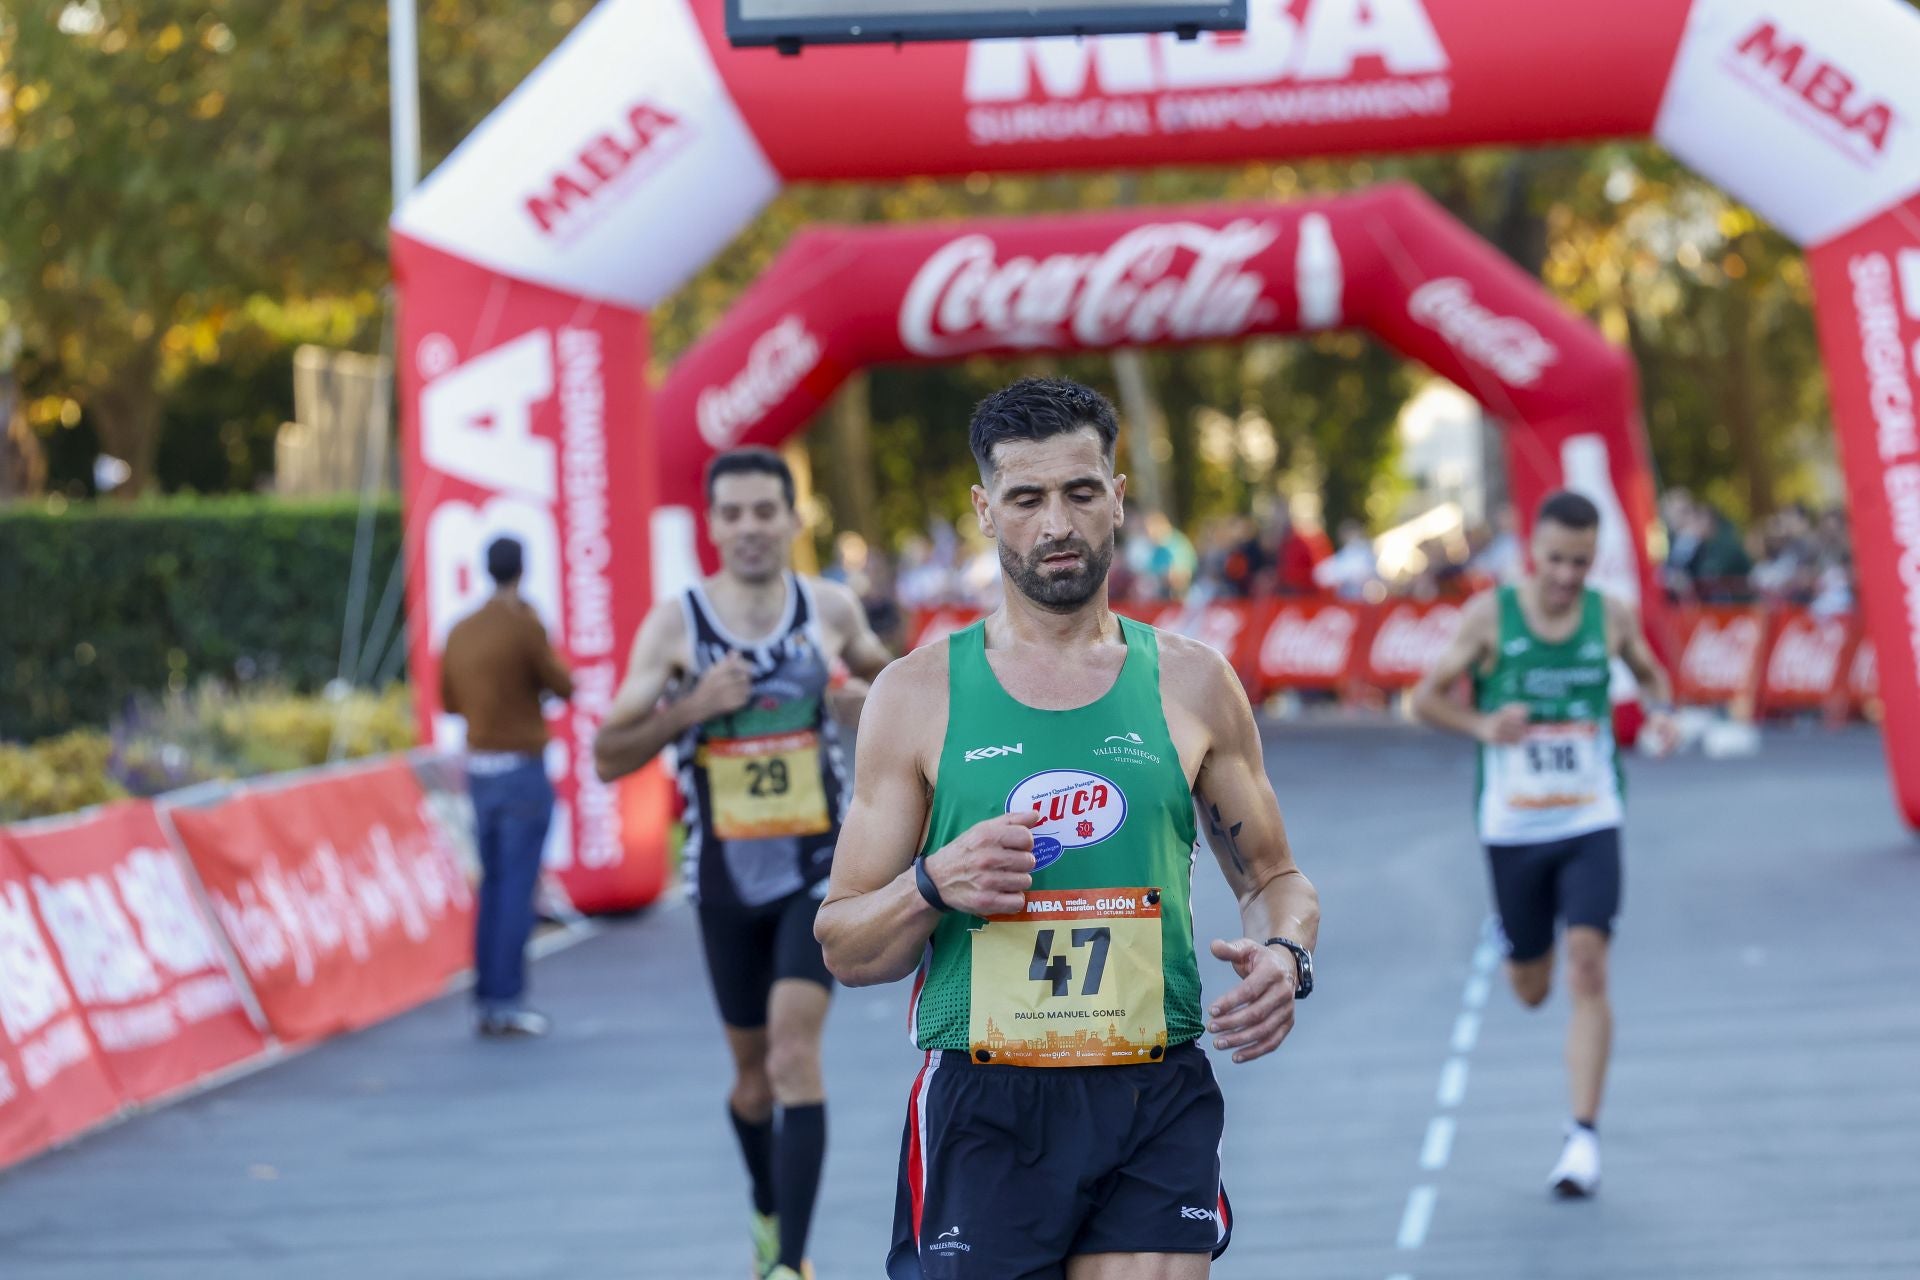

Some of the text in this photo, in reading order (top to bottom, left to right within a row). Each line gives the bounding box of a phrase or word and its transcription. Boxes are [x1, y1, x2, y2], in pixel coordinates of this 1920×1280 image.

[1736, 17, 1897, 153] MBA
[966, 76, 1452, 146] SURGICAL EMPOWERMENT
[523, 102, 680, 235] MBA
[903, 219, 1283, 357] Coca-Cola
[964, 742, 1023, 762] KON
[1093, 747, 1160, 764] VALLES PASIEGOS
[745, 758, 789, 798] 29
[1079, 823, 1090, 832] 50
[1026, 900, 1064, 912] MBA
[1065, 904, 1095, 912] maratón
[1096, 896, 1136, 910] GIJÓN
[1029, 927, 1111, 996] 47
[1014, 1009, 1126, 1020] PAULO MANUEL GOMES
[1180, 1206, 1217, 1221] KON
